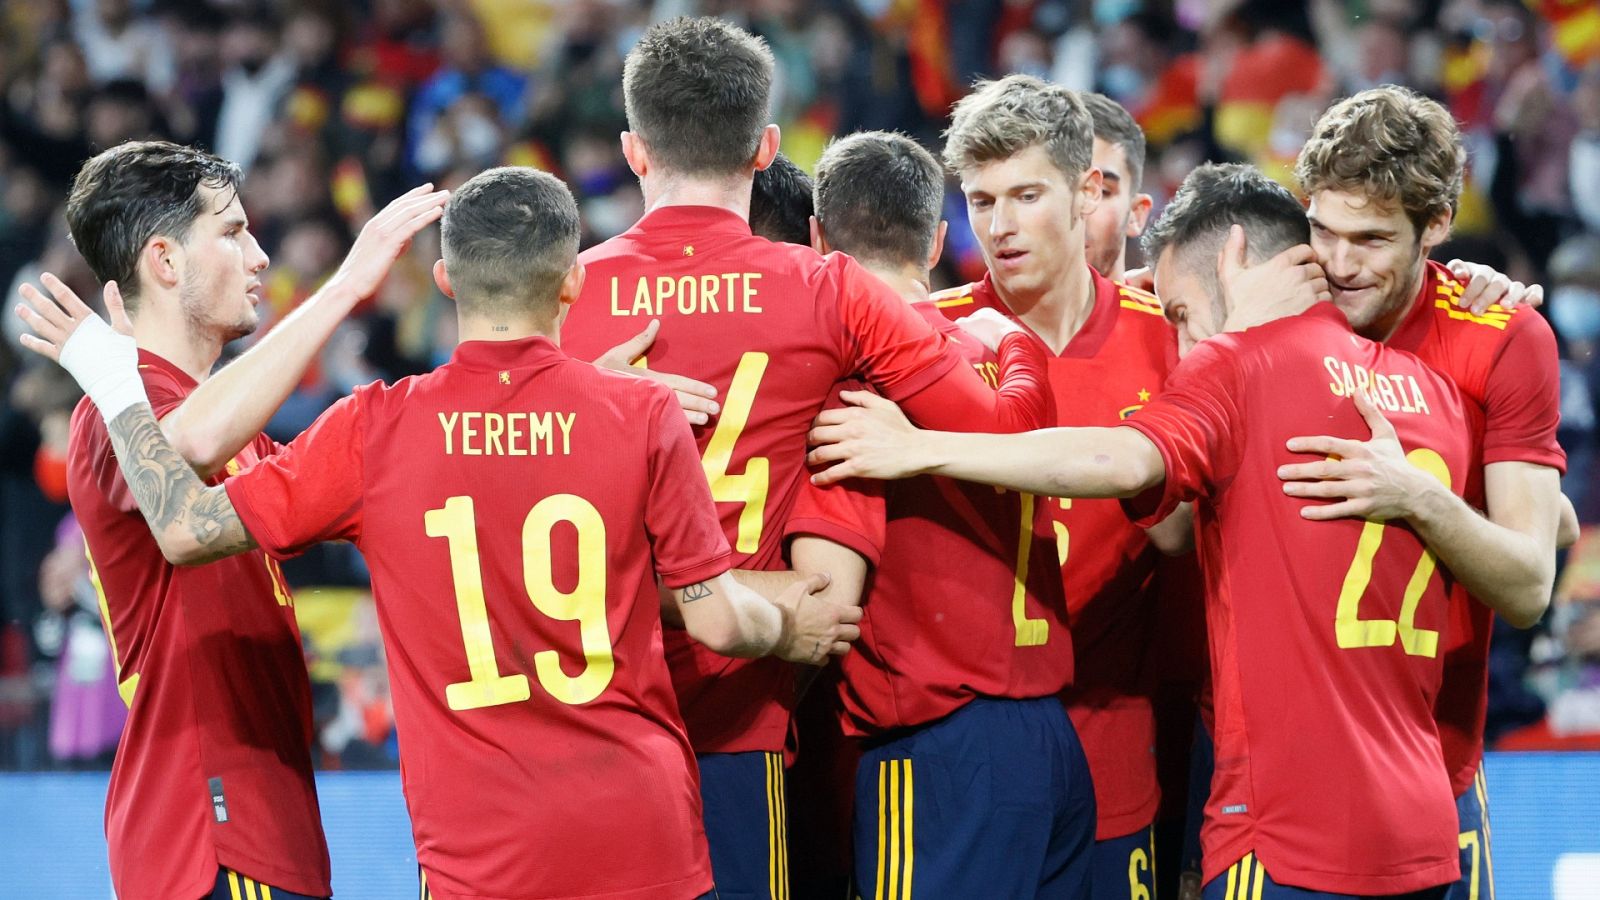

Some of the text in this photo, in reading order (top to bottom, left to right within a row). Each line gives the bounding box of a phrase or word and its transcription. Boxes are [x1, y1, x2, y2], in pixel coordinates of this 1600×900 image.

[610, 272, 763, 317] LAPORTE
[1323, 356, 1431, 415] SARABIA
[437, 411, 577, 456] YEREMY
[424, 493, 616, 711] 19
[1129, 848, 1151, 900] 6
